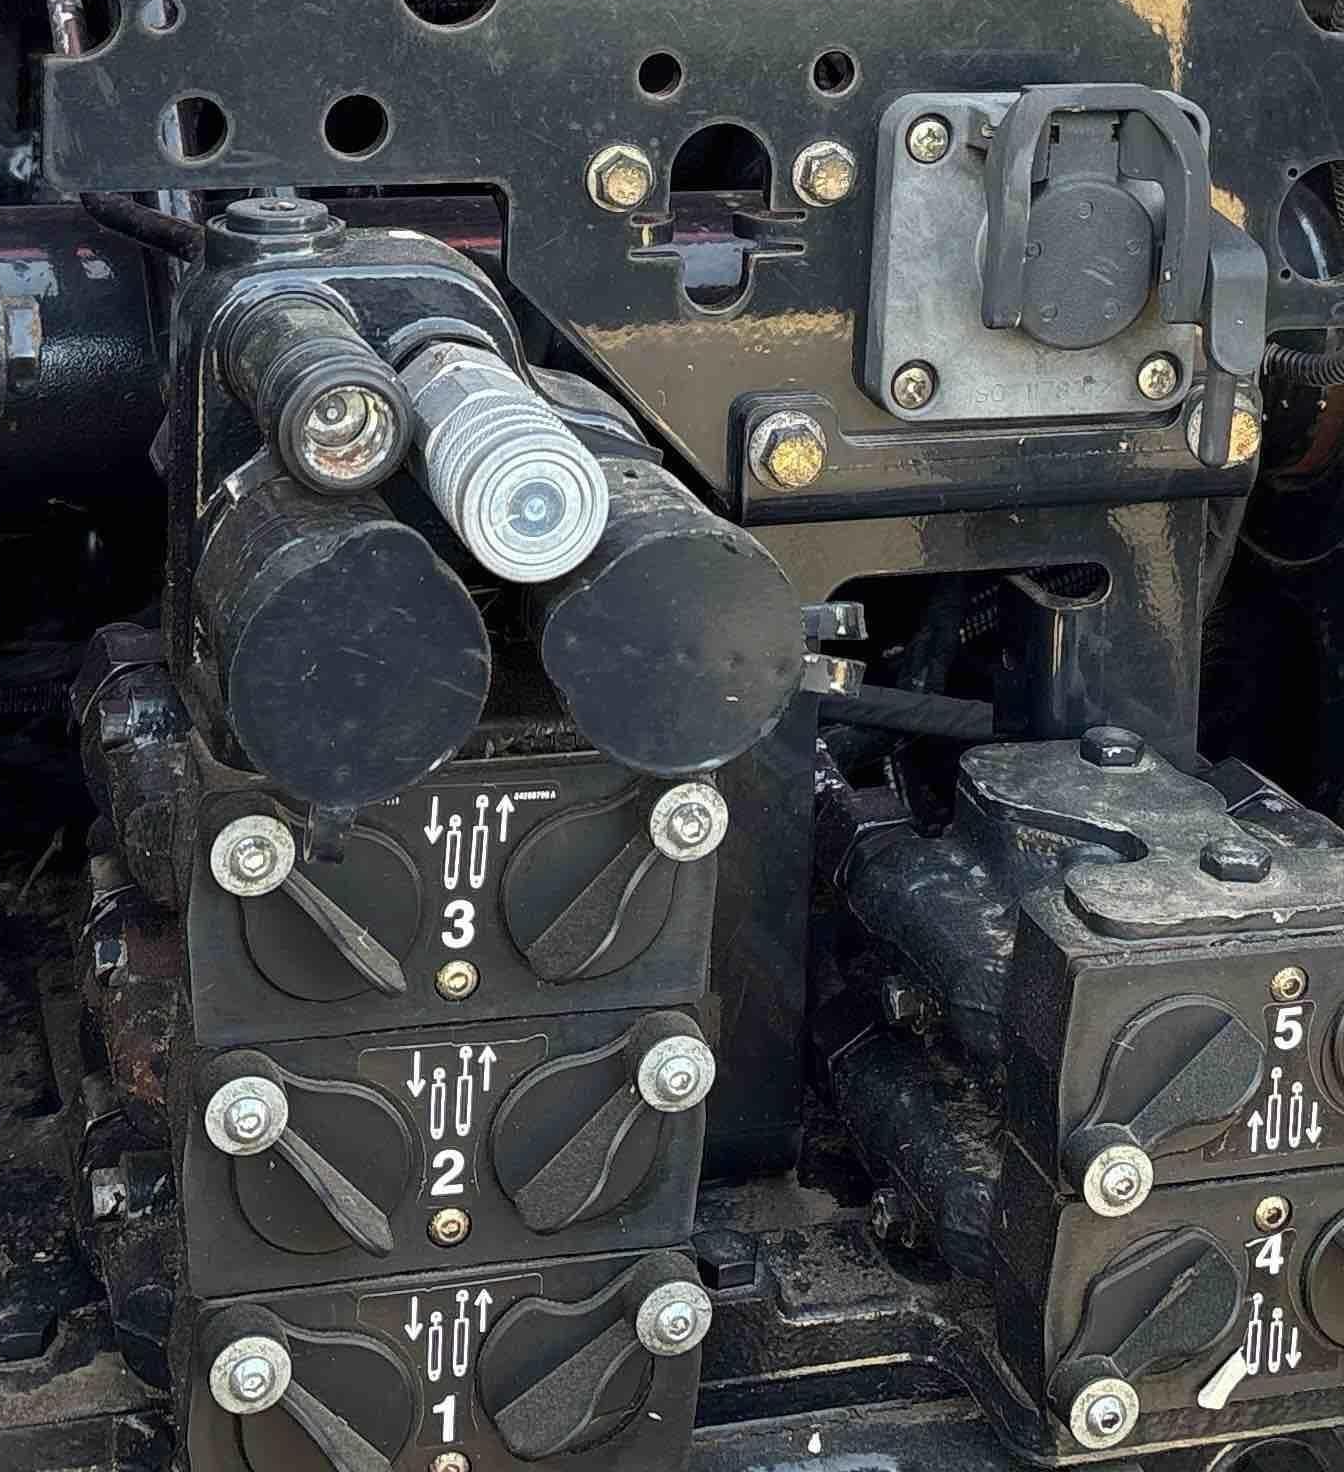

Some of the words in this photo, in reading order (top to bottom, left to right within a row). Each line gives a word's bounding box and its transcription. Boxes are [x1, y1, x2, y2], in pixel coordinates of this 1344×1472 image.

[441, 900, 475, 948] 3
[1273, 1007, 1304, 1050] 5
[431, 1150, 464, 1195] 2
[1255, 1234, 1283, 1274] 4
[432, 1396, 457, 1442] 1
